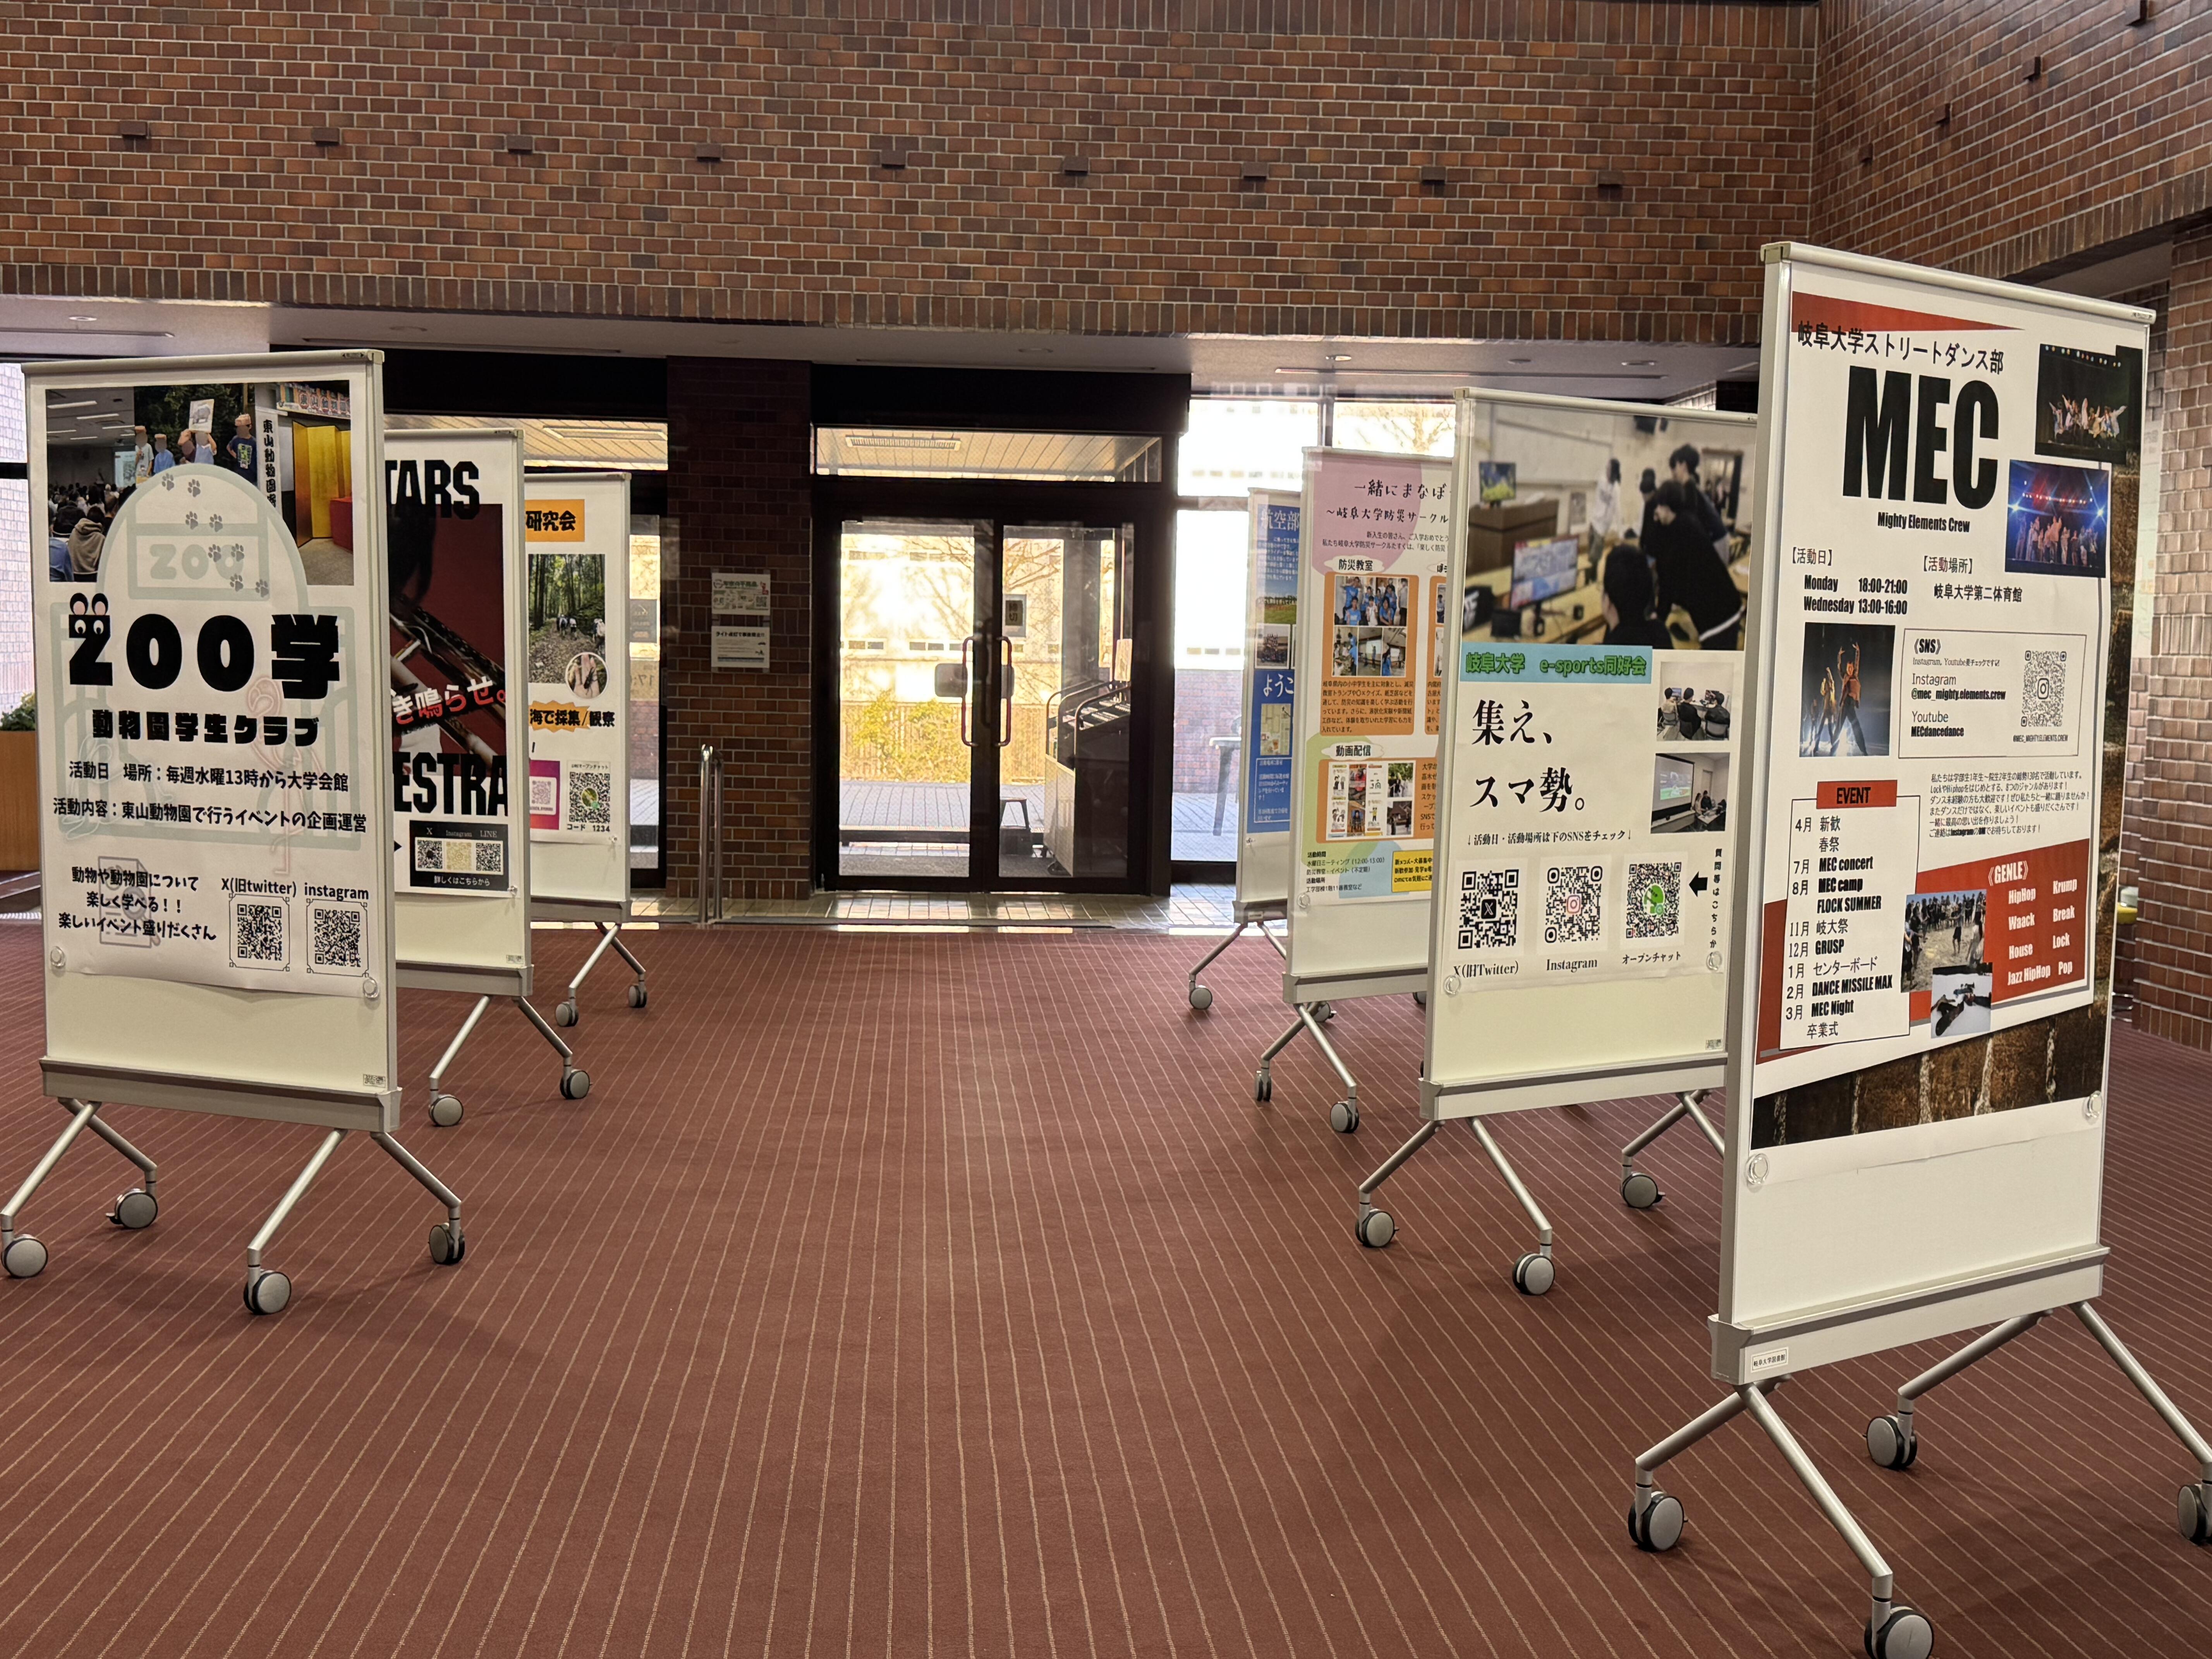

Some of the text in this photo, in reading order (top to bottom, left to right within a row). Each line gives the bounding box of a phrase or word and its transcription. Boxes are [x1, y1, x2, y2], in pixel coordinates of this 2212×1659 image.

[1798, 321, 2004, 375] 岐阜大学ストリートダンス部
[1843, 366, 1999, 510] MEC
[526, 510, 576, 531] 研究会
[1878, 512, 1970, 532] Mighty Elements Crew
[1339, 559, 1373, 571] 防災教室
[1792, 547, 1833, 566] 【活動日】
[1923, 555, 1973, 574] 【活動場所】
[1805, 575, 1908, 594] Monday 18:00-21:00
[1934, 583, 2023, 603] 岐阜大学第二体育館
[1804, 596, 1908, 615] Wednesday 13:00-16:00
[1465, 653, 1646, 676] 岐阜大学 e-sports同好会
[1912, 673, 1956, 686] Instagram
[390, 676, 506, 724] き鳴らせ。
[1472, 699, 1552, 745] 集え、
[1912, 711, 1948, 723] Youtube
[93, 709, 319, 747] 動物園学生クラブ
[1911, 726, 1964, 737] MECdancedance
[1336, 745, 1371, 757] 動画配信
[69, 761, 348, 792] 活動日 場所：毎週水曜13時から大学会館
[1470, 767, 1585, 813] スマ勢。
[1837, 787, 1871, 804] EVENT
[53, 798, 366, 833] 活動内容：東山動物園で行うイベントの企画運営
[1795, 815, 1841, 833] 4月 新歓
[1819, 836, 1839, 852] 春祭
[1794, 856, 1873, 874] 7月 MEC concert
[72, 866, 199, 891] 動物や動物園について
[434, 875, 490, 886] 詳しくはこちらから
[1793, 878, 1863, 895] 8月 MEC camp
[2053, 879, 2077, 895] Krump
[304, 883, 369, 902] instagram
[2008, 888, 2036, 905] HipHop
[1710, 848, 1723, 957] 質問等はこちらか
[1817, 896, 1881, 914] FLOCK SUMMER
[2009, 913, 2035, 930] Waack
[2053, 905, 2075, 922] Break
[59, 912, 216, 940] 楽しいイベント盛りだくさん
[1790, 918, 1848, 936] 11月 岐大祭
[1789, 939, 1844, 957] 12月 GRUSP
[2053, 933, 2070, 949] Lock
[1622, 951, 1681, 965] オープンチャット
[2009, 944, 2033, 960] House
[1546, 958, 1598, 972] Instagram
[1788, 956, 1878, 979] 1月 センターボード
[2058, 961, 2073, 975] Pop
[2008, 965, 2051, 986] Jazz HipHop
[1787, 975, 1893, 1000] 2月 DANCE MISSILE MAX
[1786, 1000, 1854, 1020] 3月 MEC Night
[1807, 1021, 1838, 1039] 卒業式
[1754, 1354, 1785, 1367] 岐阜大学図書館
